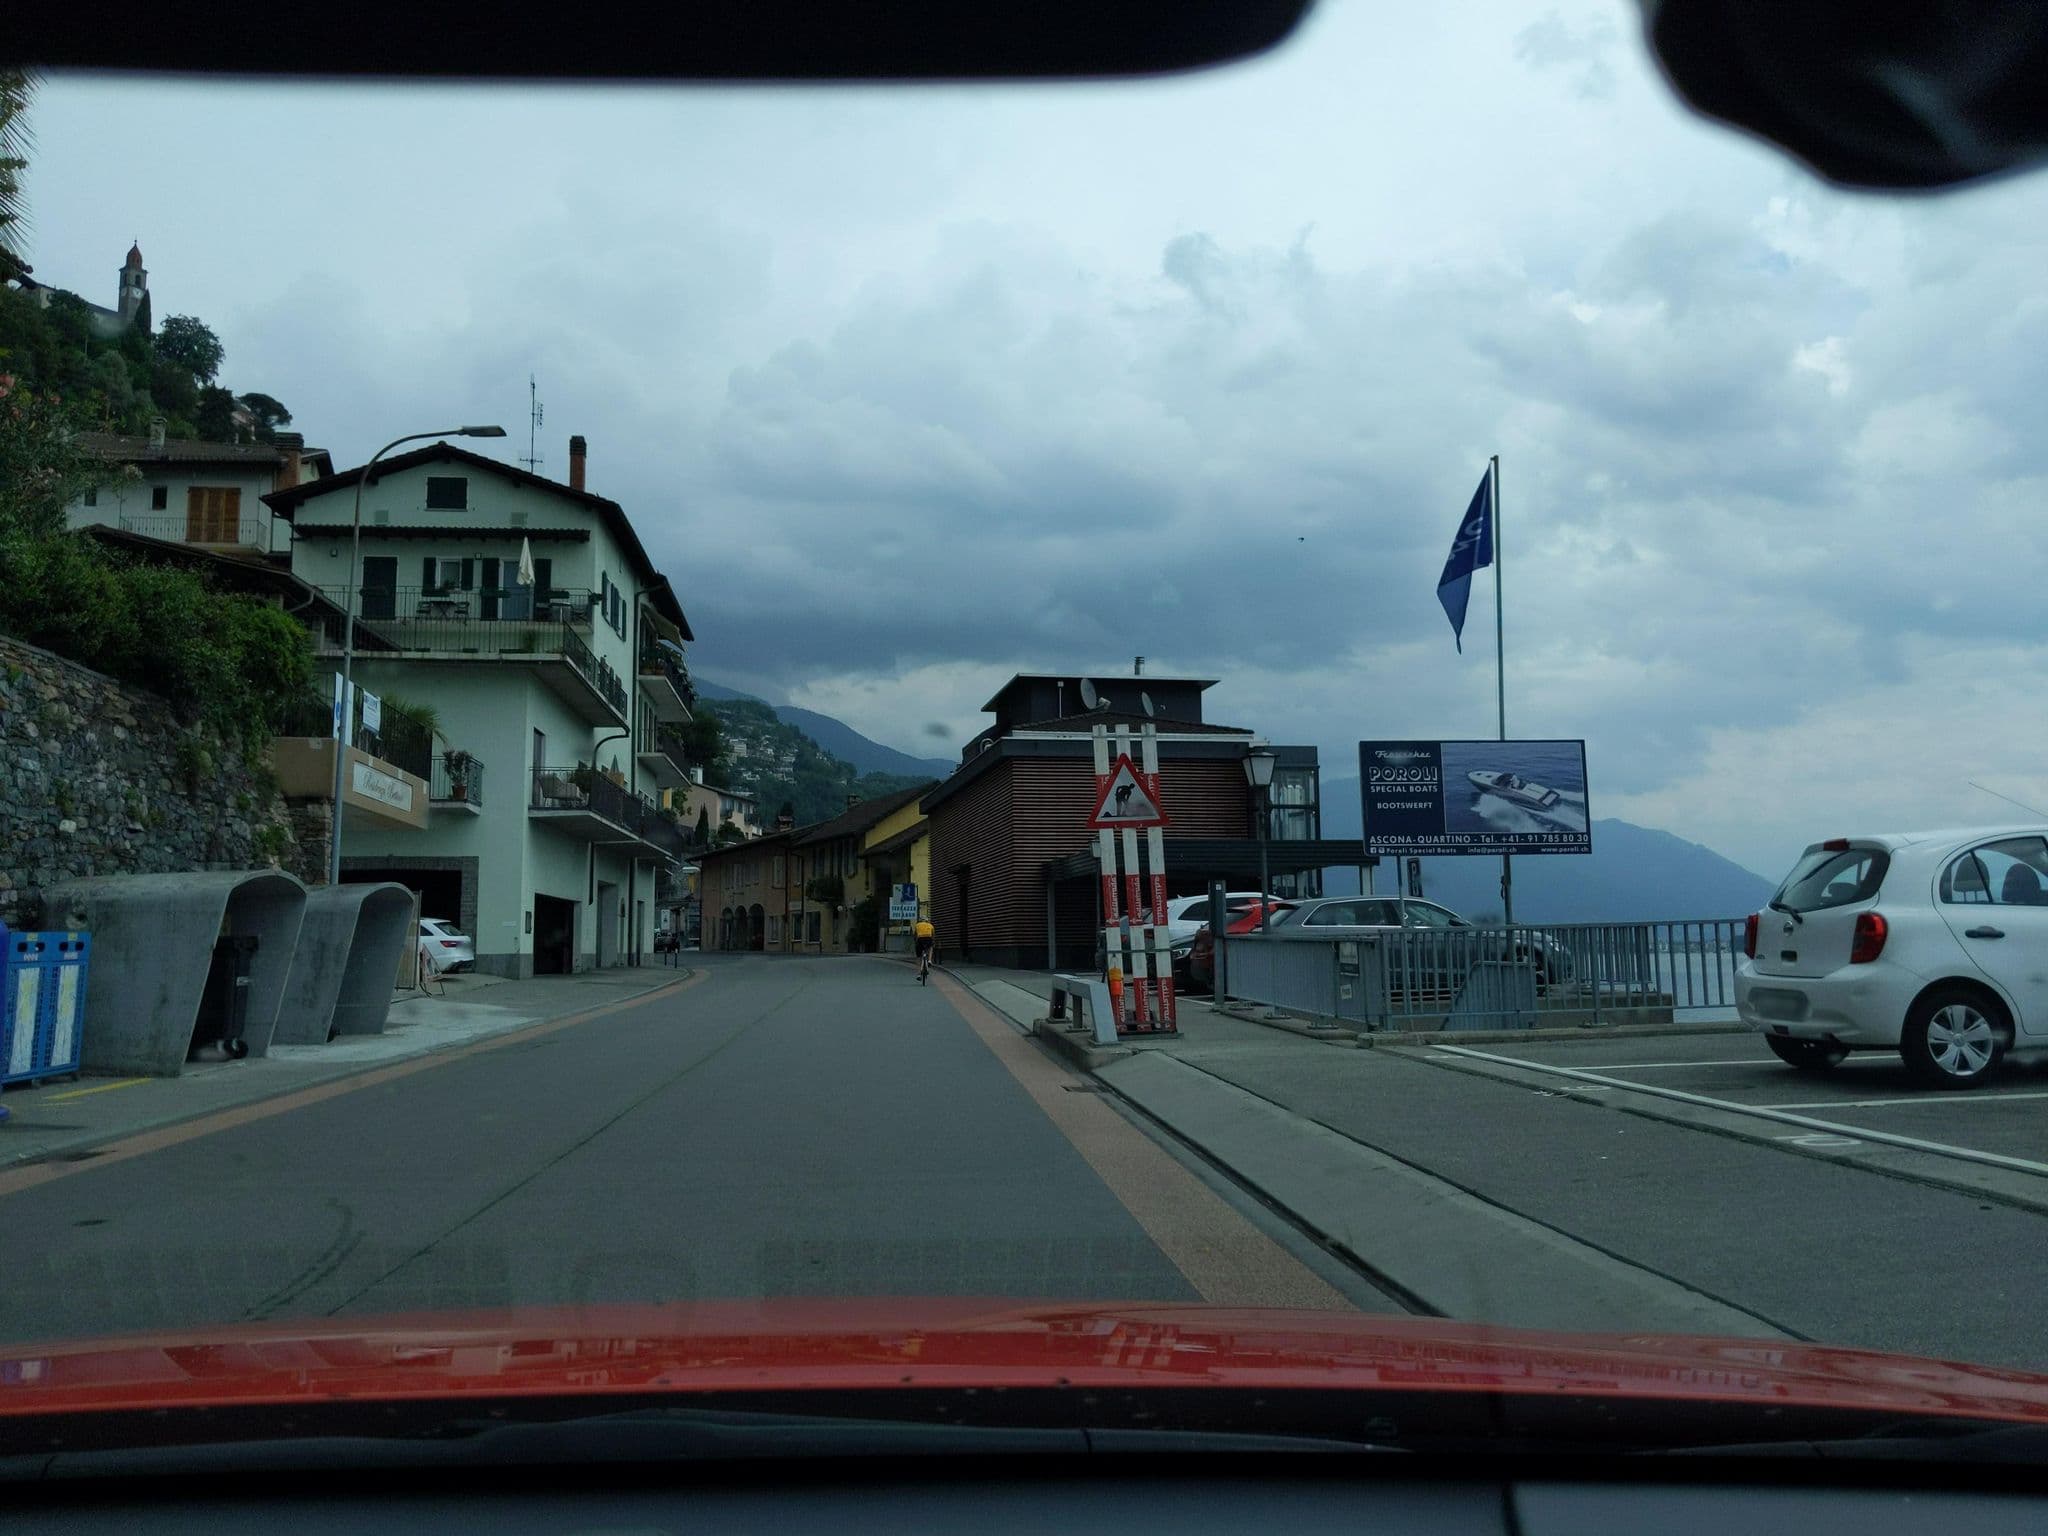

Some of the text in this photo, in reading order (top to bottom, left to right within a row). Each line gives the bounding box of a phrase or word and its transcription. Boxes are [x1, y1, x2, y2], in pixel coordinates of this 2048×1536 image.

[1369, 767, 1438, 781] POROLI
[1370, 785, 1438, 793] SPECIAL BOATS
[1369, 835, 1471, 844] ASCONA-QUARTINO
[1480, 834, 1498, 843] Tel.
[1528, 834, 1538, 842] 91
[1542, 834, 1560, 843] 785
[1562, 834, 1574, 842] 80
[1577, 834, 1589, 842] 30
